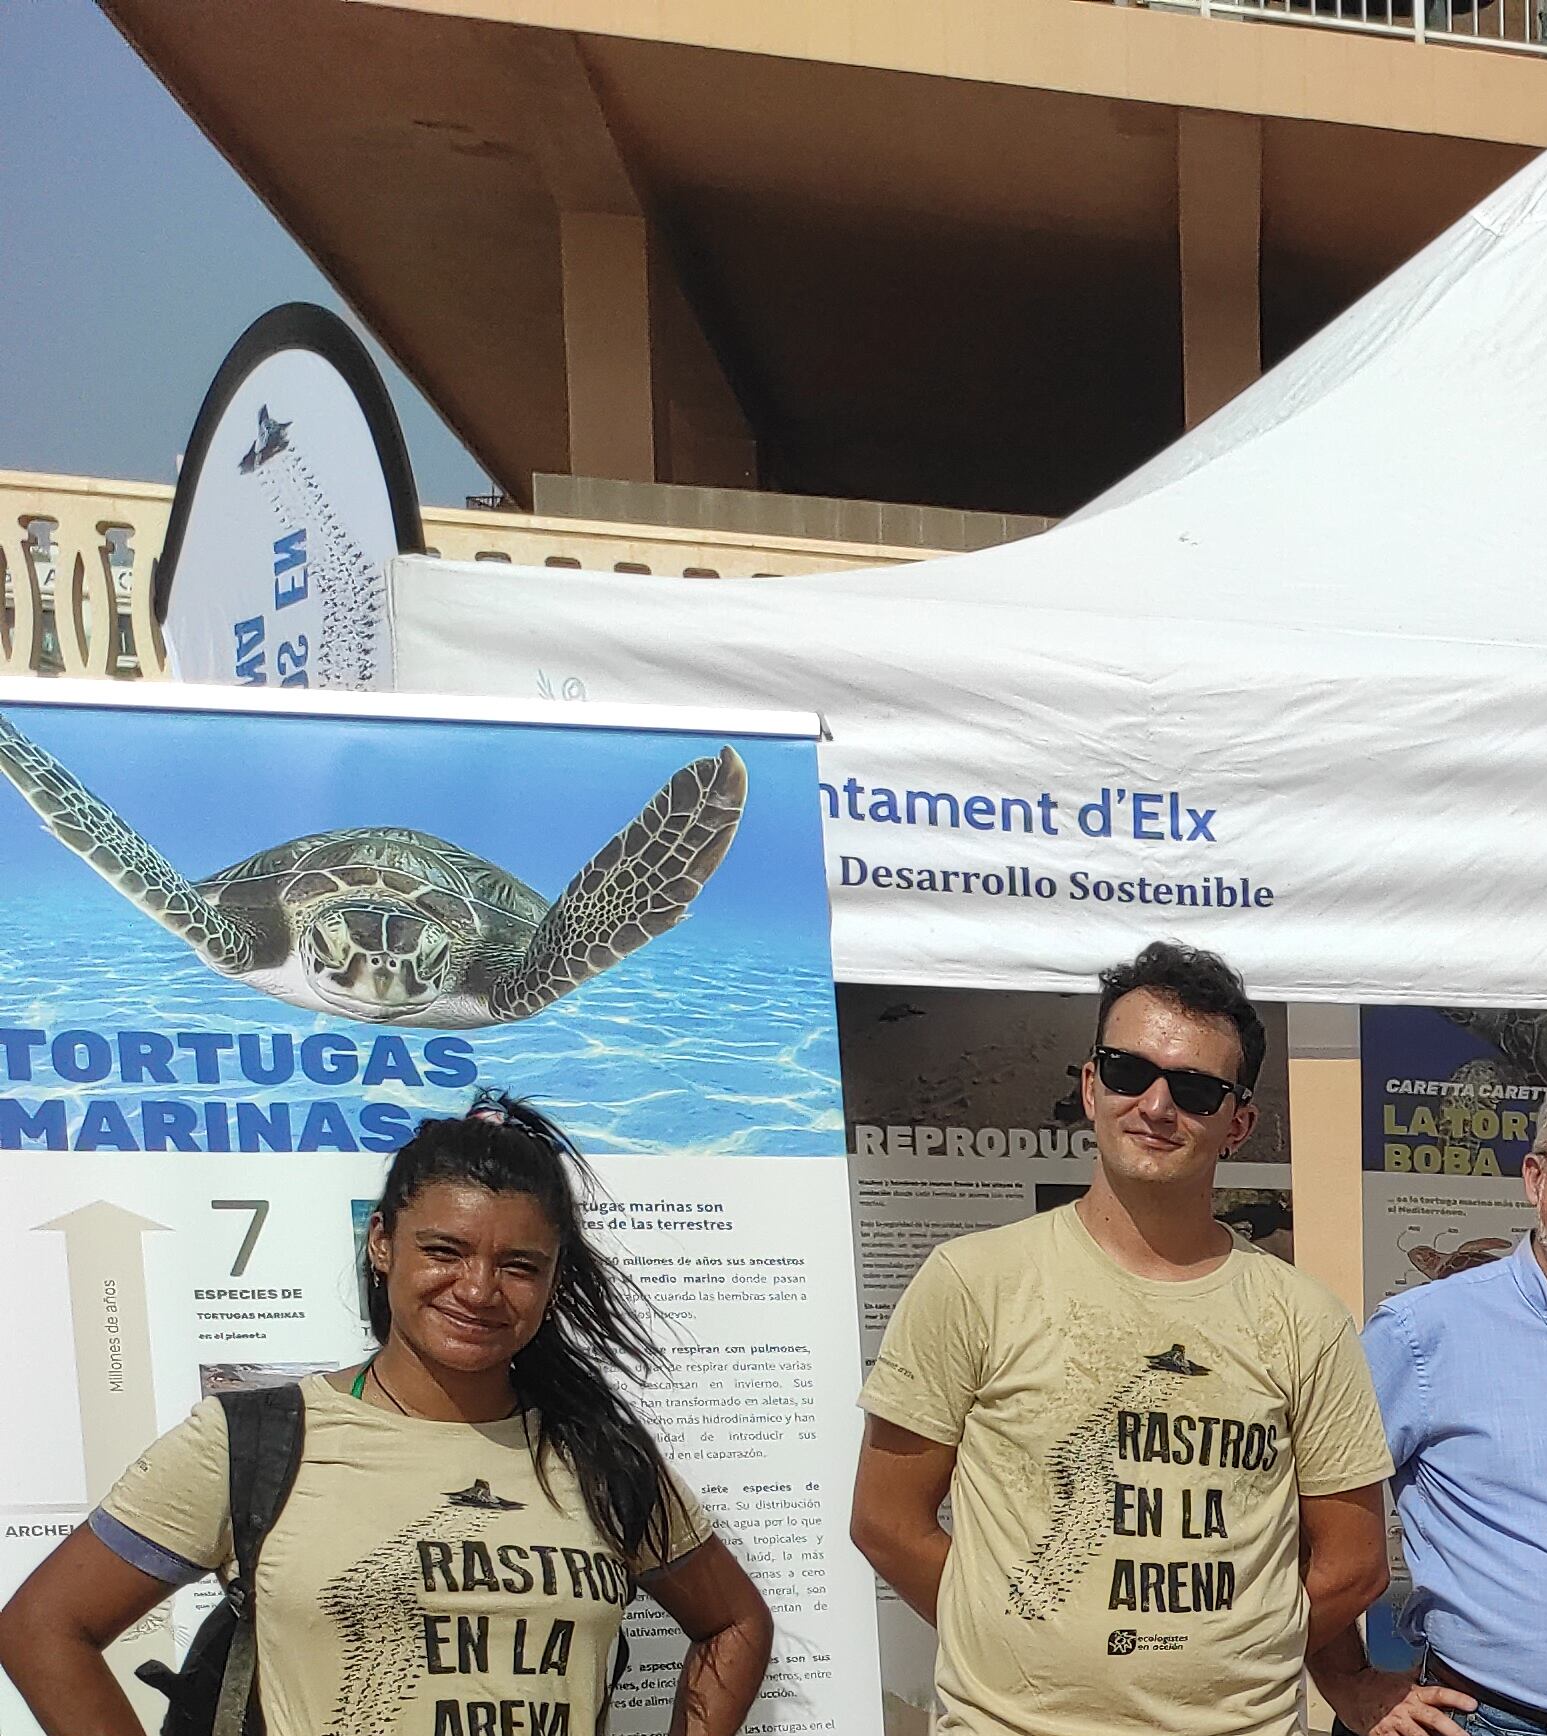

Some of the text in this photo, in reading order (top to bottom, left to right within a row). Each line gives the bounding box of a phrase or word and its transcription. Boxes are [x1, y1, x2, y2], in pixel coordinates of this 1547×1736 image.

[1078, 787, 1218, 843] d'Elx
[839, 855, 1275, 908] Desarrollo Sostenible
[0, 1028, 477, 1087] TORTUGAS
[1385, 1078, 1475, 1098] CARETTA
[0, 1098, 413, 1153] MARINAS
[1383, 1103, 1440, 1138] LA
[1383, 1142, 1503, 1178] BOBA
[629, 1199, 724, 1213] marinas son
[607, 1217, 733, 1231] de las terrestres
[210, 1200, 270, 1277] 7
[623, 1256, 805, 1267] millones de años sus ancestros
[640, 1273, 806, 1286] medio marino donde pasan
[194, 1288, 303, 1300] ESPECIES DE
[699, 1290, 799, 1301] las salen
[197, 1311, 256, 1320] TORTUGAS
[103, 1279, 125, 1393] Millones de años
[671, 1343, 745, 1356] respiran con
[686, 1361, 812, 1373] respirar durante varias
[709, 1378, 813, 1389] en Sus
[744, 1397, 814, 1406] en su
[676, 1412, 816, 1426] más hidrodinámico y han
[700, 1432, 715, 1442] de
[798, 1432, 817, 1441] sus
[1117, 1409, 1279, 1472] RASTROS
[677, 1449, 704, 1460] en el
[701, 1481, 821, 1495] siete especies de
[735, 1500, 821, 1510] Su distribución
[1113, 1480, 1229, 1540] EN LA
[733, 1516, 822, 1531] agua lo que
[753, 1533, 824, 1546] tropicales y
[782, 1551, 825, 1561] la más
[417, 1539, 636, 1608] RASTROS
[801, 1568, 826, 1577] cero
[807, 1585, 827, 1594] son
[1107, 1558, 1236, 1613] ARENA
[813, 1601, 829, 1611] de
[422, 1613, 576, 1678] EN LA
[786, 1653, 831, 1663] son sus
[804, 1670, 832, 1680] entre
[762, 1722, 824, 1734] tortugas en
